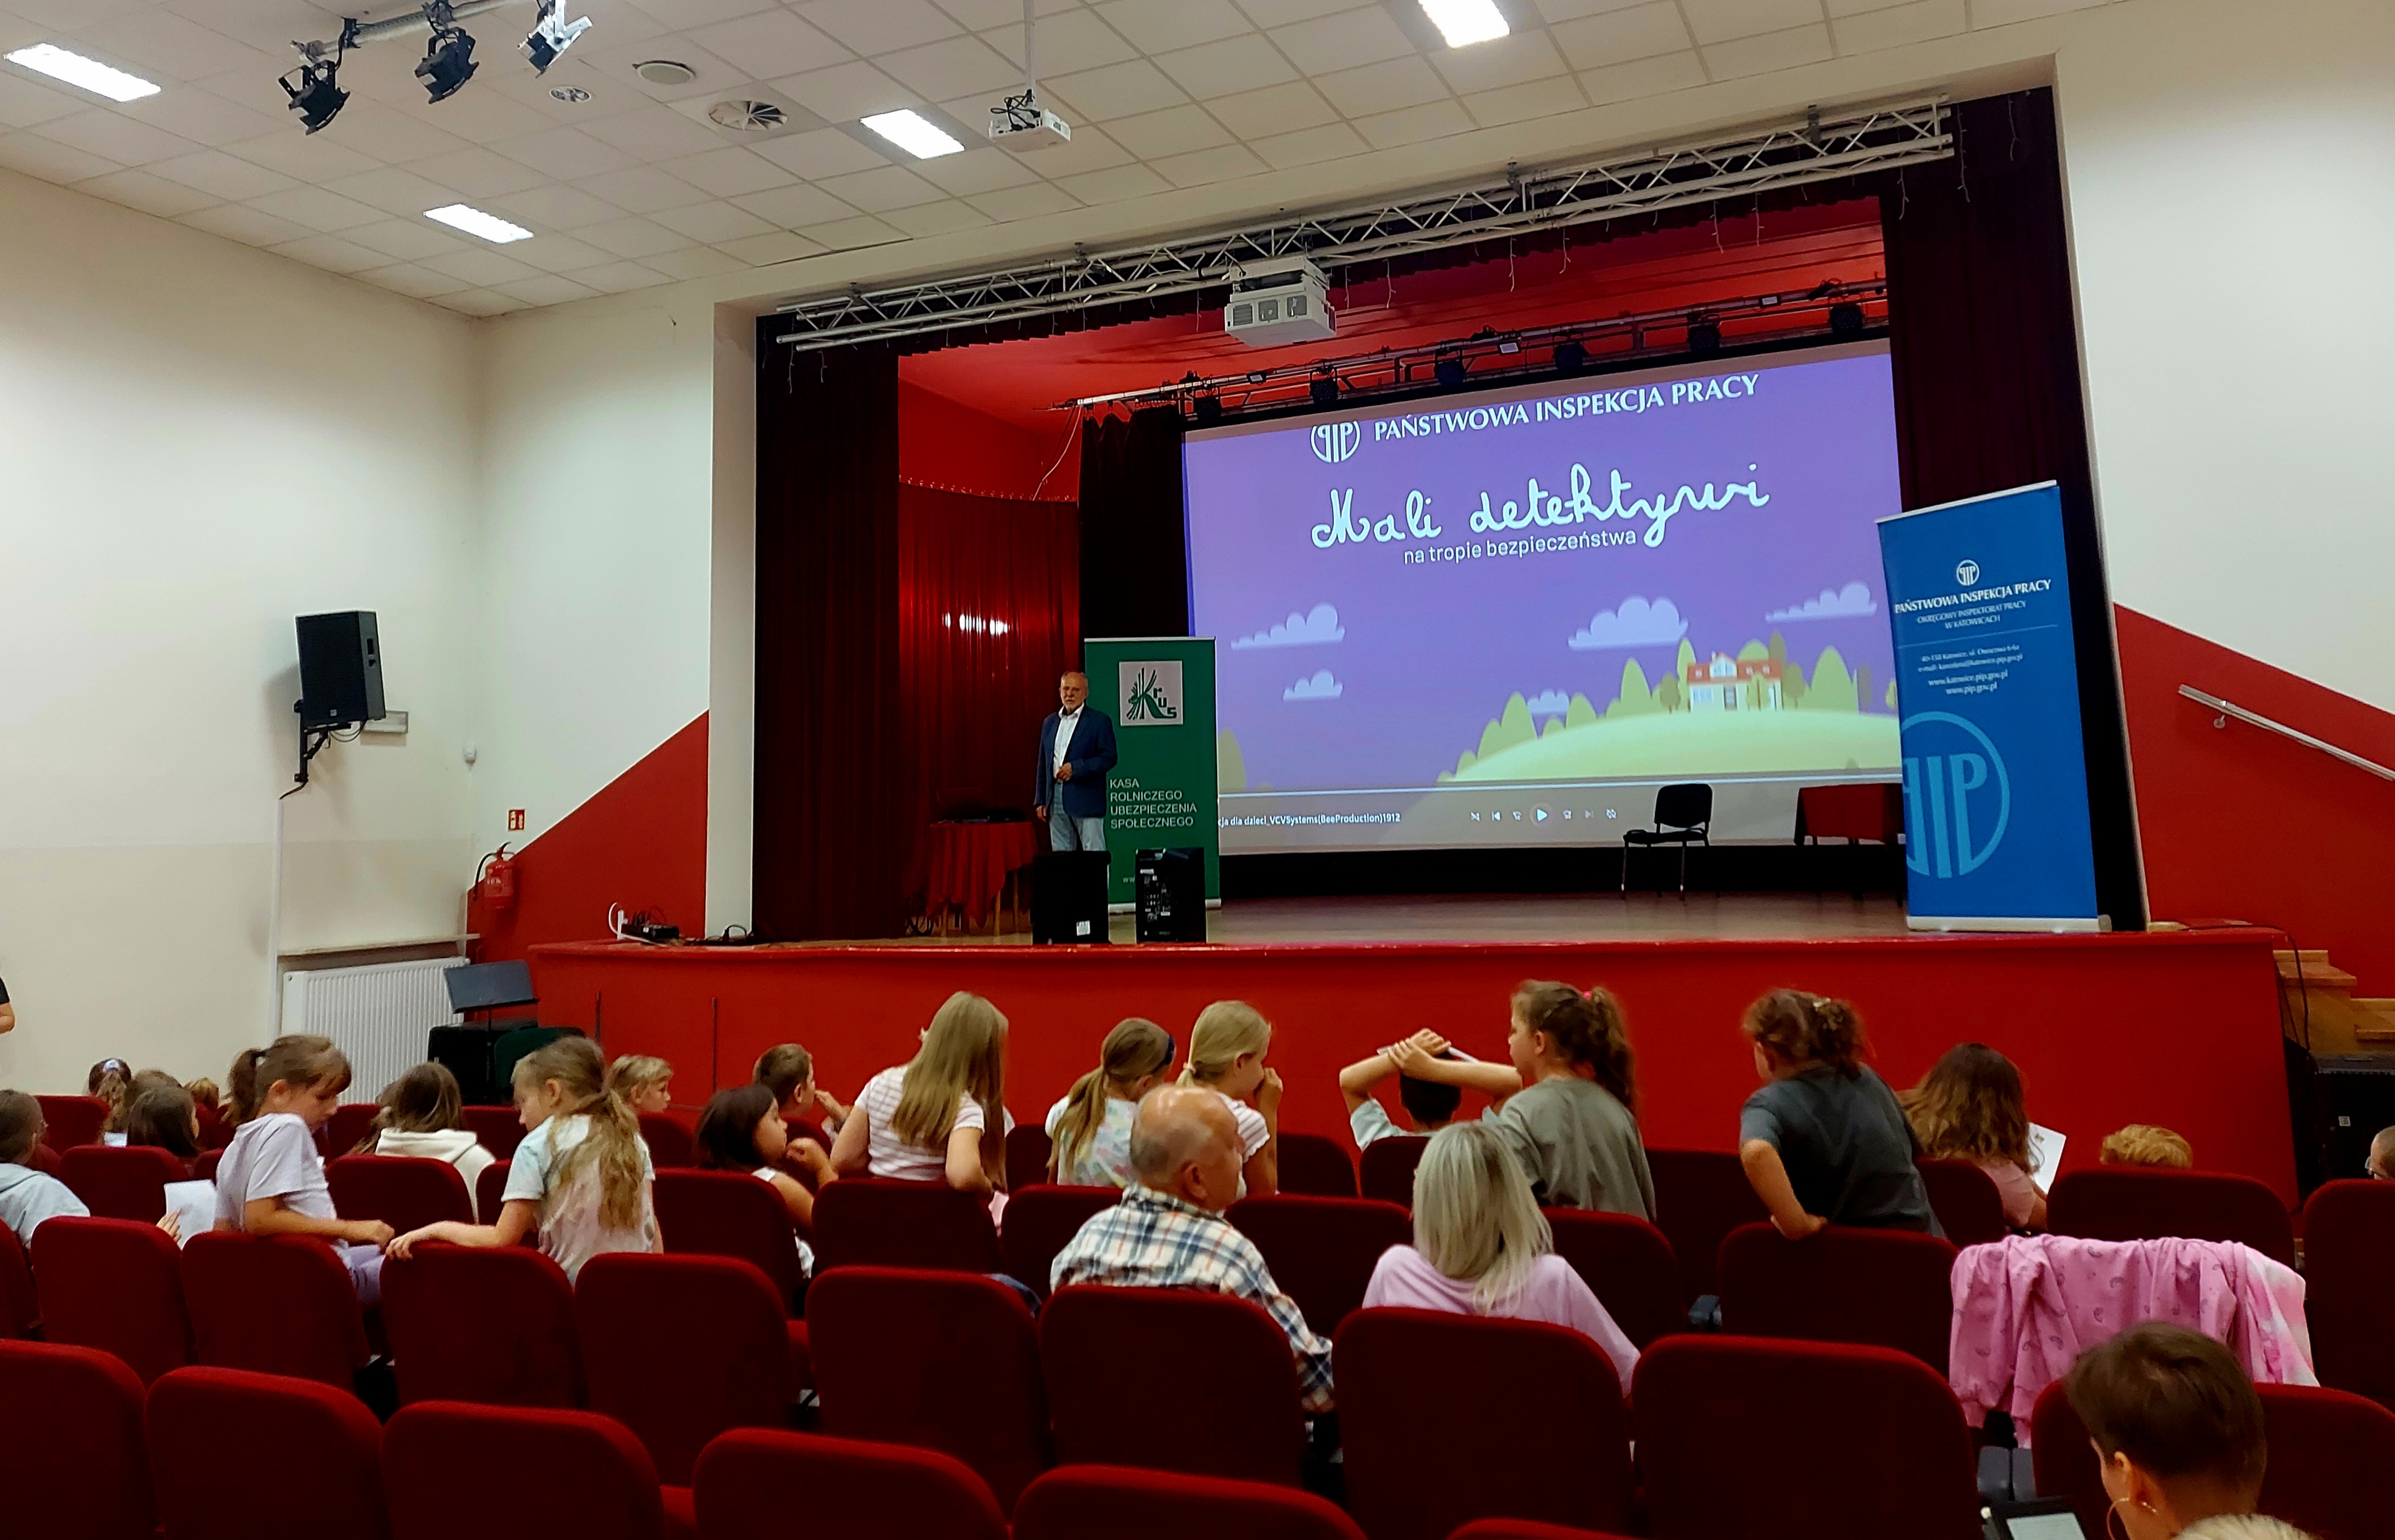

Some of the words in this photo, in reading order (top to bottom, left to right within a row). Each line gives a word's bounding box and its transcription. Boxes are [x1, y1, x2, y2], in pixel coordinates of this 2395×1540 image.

[1375, 404, 1529, 441] PAŃSTWOWA
[1536, 387, 1664, 422] INSPEKCJA
[1671, 374, 1759, 405] PRACY
[1311, 488, 1442, 549] Mali
[1469, 462, 1770, 548] detektywi
[1404, 550, 1425, 565] na
[1428, 541, 1482, 564] tropie
[1486, 529, 1636, 558] bezpieczeństwa
[1894, 595, 1959, 614] PAŃSTWOWA
[1960, 585, 2013, 604] INSPEKCJA
[2014, 579, 2052, 595] PRACY
[1958, 604, 2003, 617] INSPEKTORAT
[2003, 600, 2027, 610] PRACY
[1953, 614, 2000, 628] KATOWICACH
[1110, 778, 1140, 789] KASA
[1110, 790, 1183, 802] ROLNICZEGO
[1110, 802, 1198, 816] UBEZPIECZENIA
[1110, 816, 1194, 830] SPOŁECZNEGO
[1217, 816, 1229, 828] cja
[1230, 816, 1243, 826] dla
